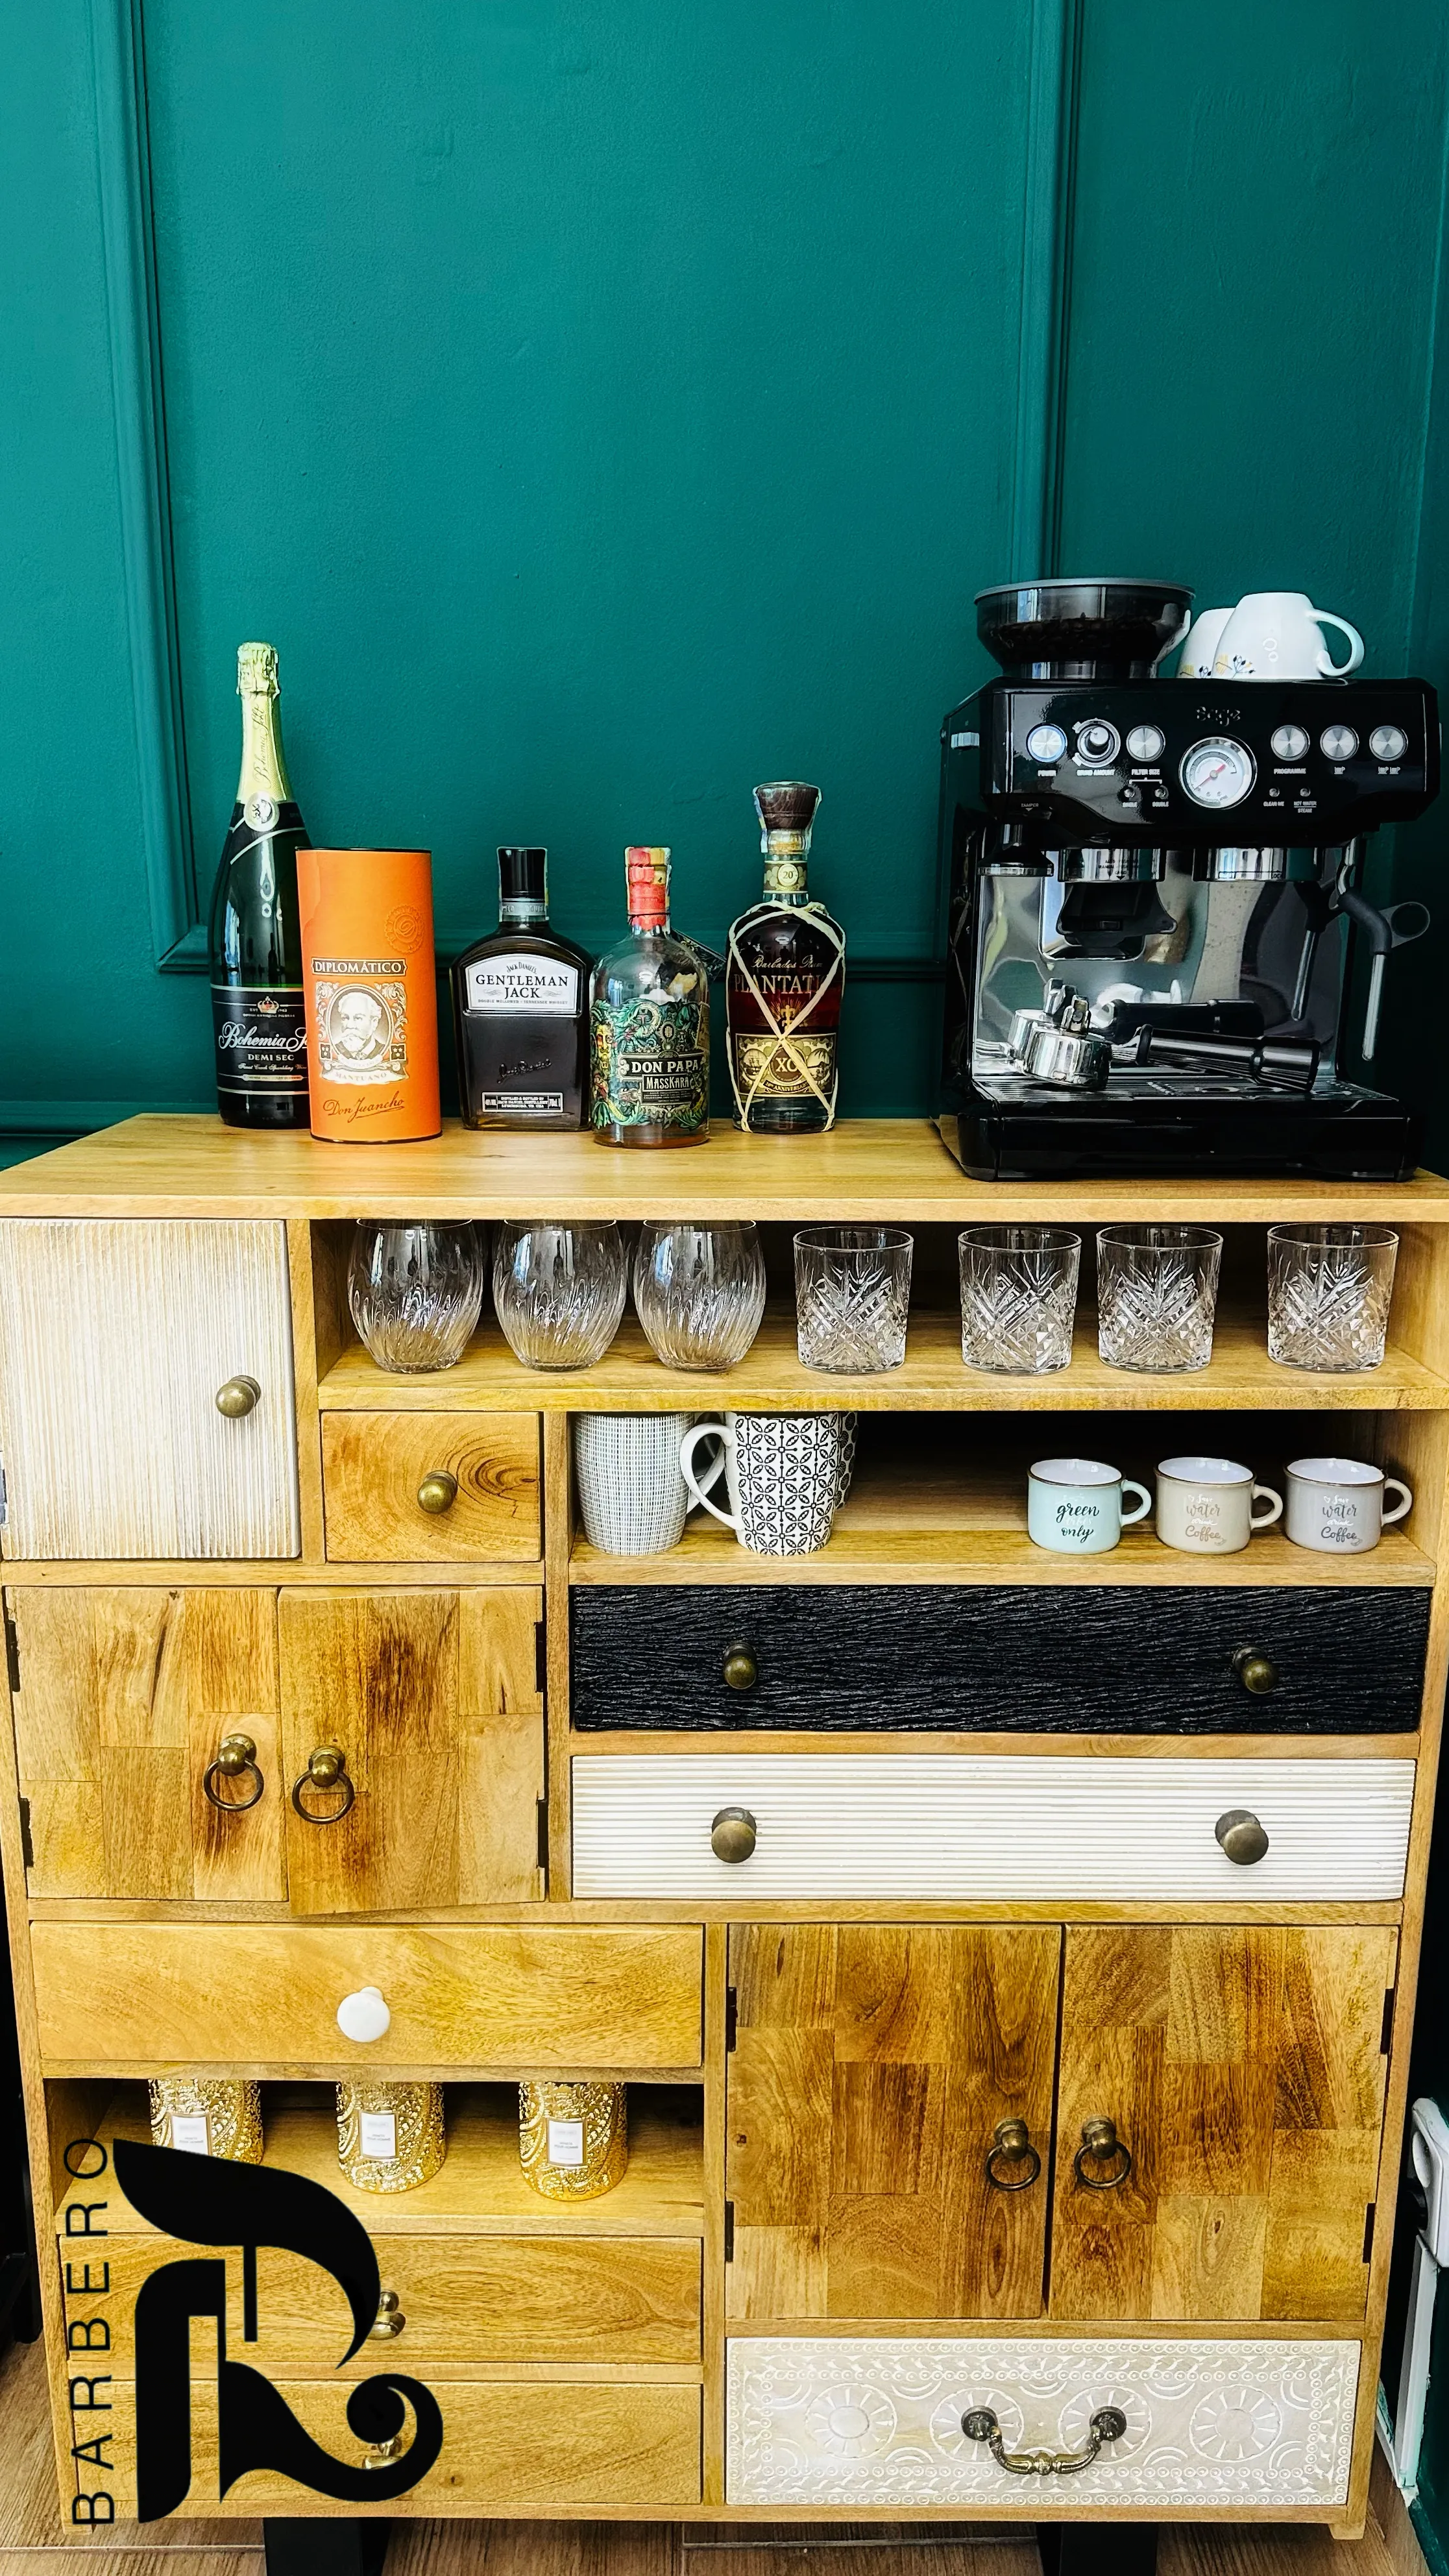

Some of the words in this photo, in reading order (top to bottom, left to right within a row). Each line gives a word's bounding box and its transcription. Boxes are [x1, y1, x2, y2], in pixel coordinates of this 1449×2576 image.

[315, 961, 402, 973] DIPLOMÁTICO
[751, 954, 797, 968] Barbados
[799, 954, 823, 968] Rum
[476, 974, 568, 987] GENTLEMAN
[505, 987, 541, 1000] JACK
[218, 1021, 287, 1049] Bohemia
[631, 1061, 663, 1073] DON
[667, 1059, 699, 1073] PAPA
[335, 1072, 387, 1081] MANTUANO
[323, 1099, 354, 1116] Don
[347, 1090, 405, 1123] Juancho
[1056, 1503, 1100, 1523] green
[1186, 1503, 1221, 1518] water
[1322, 1504, 1358, 1519] water
[1061, 1525, 1094, 1543] only
[1185, 1525, 1221, 1542] Coffee
[1321, 1526, 1358, 1543] Coffee
